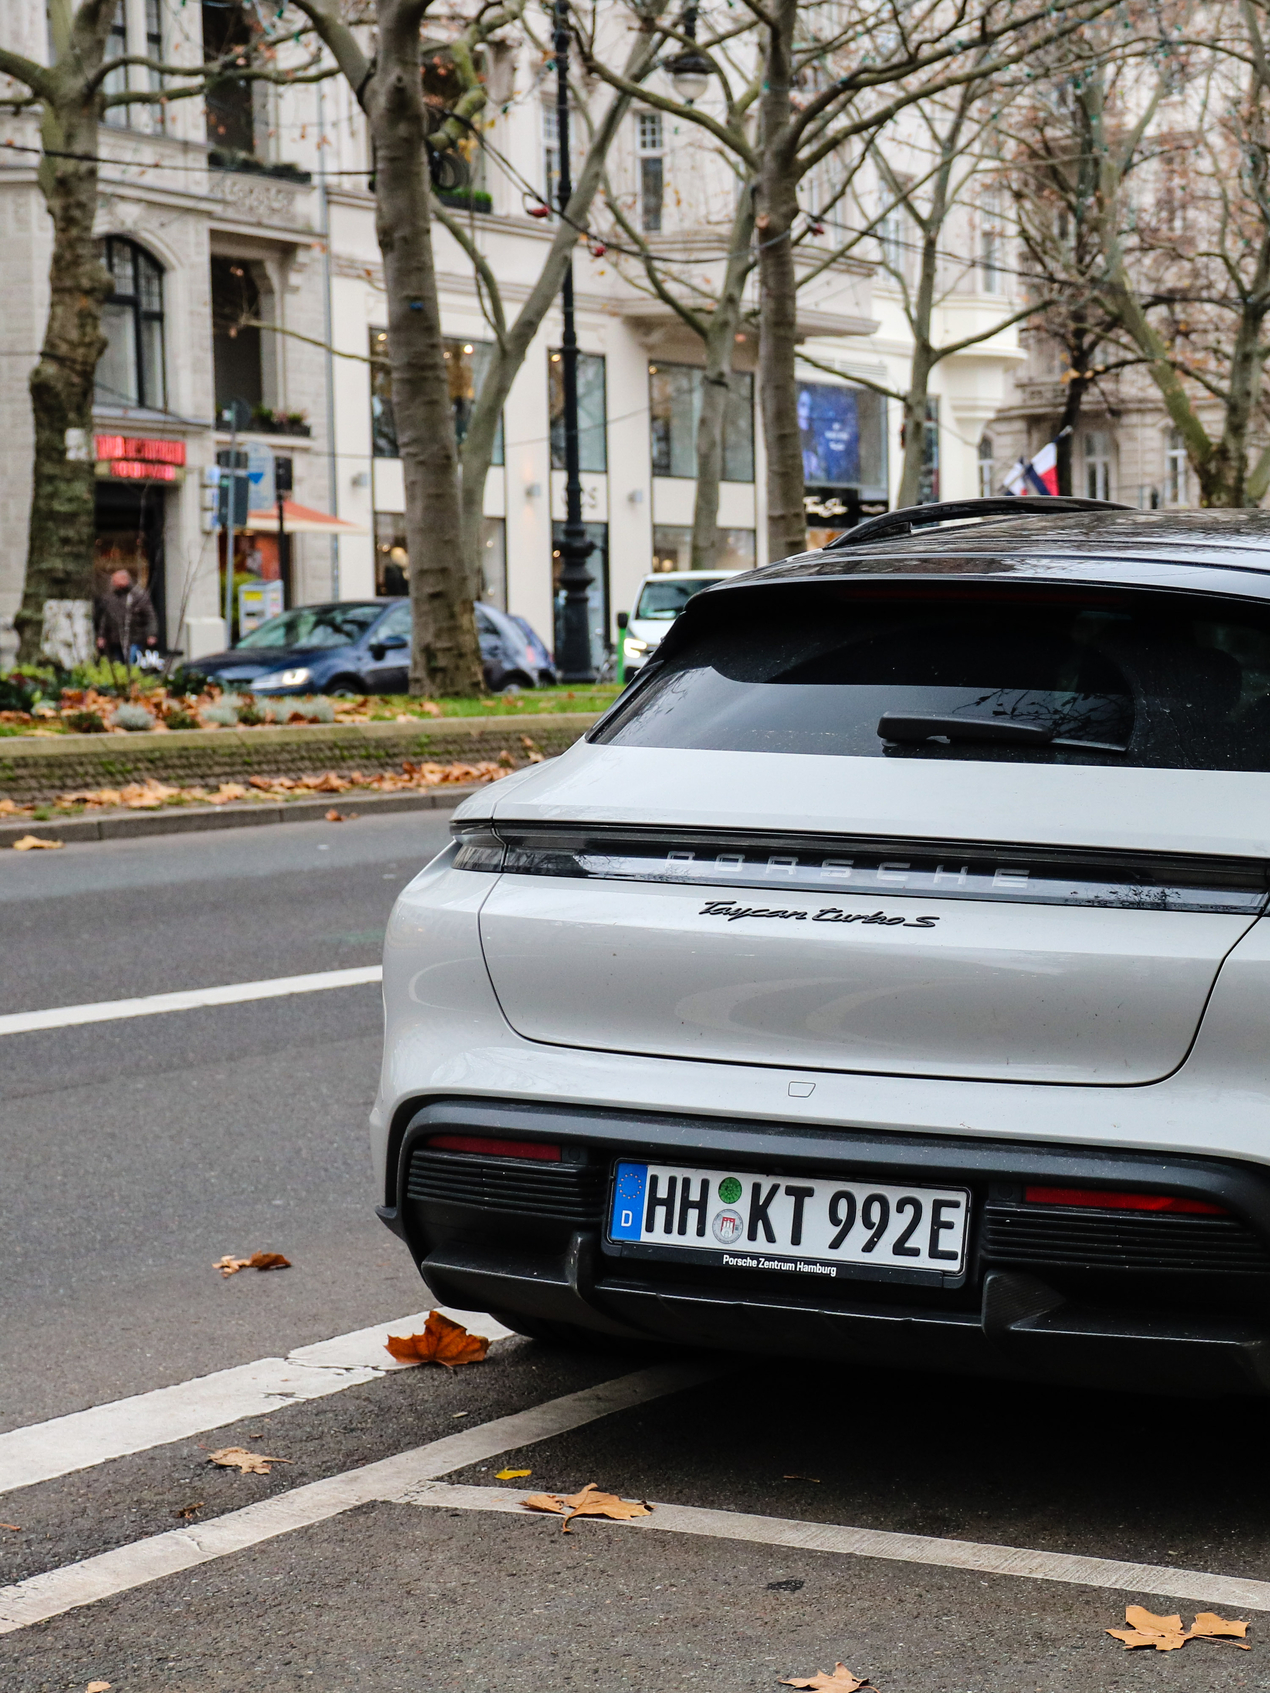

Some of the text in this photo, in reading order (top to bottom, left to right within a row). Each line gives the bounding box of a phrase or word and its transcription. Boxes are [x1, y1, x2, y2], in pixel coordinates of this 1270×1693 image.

[665, 850, 1030, 889] PORSCHE
[699, 900, 941, 928] Taycan turbo S
[620, 1209, 633, 1227] D
[645, 1174, 710, 1237] HH
[747, 1182, 815, 1246] KT
[828, 1189, 961, 1260] 992E
[723, 1255, 837, 1277] Porsche Zentrum Hamburg
